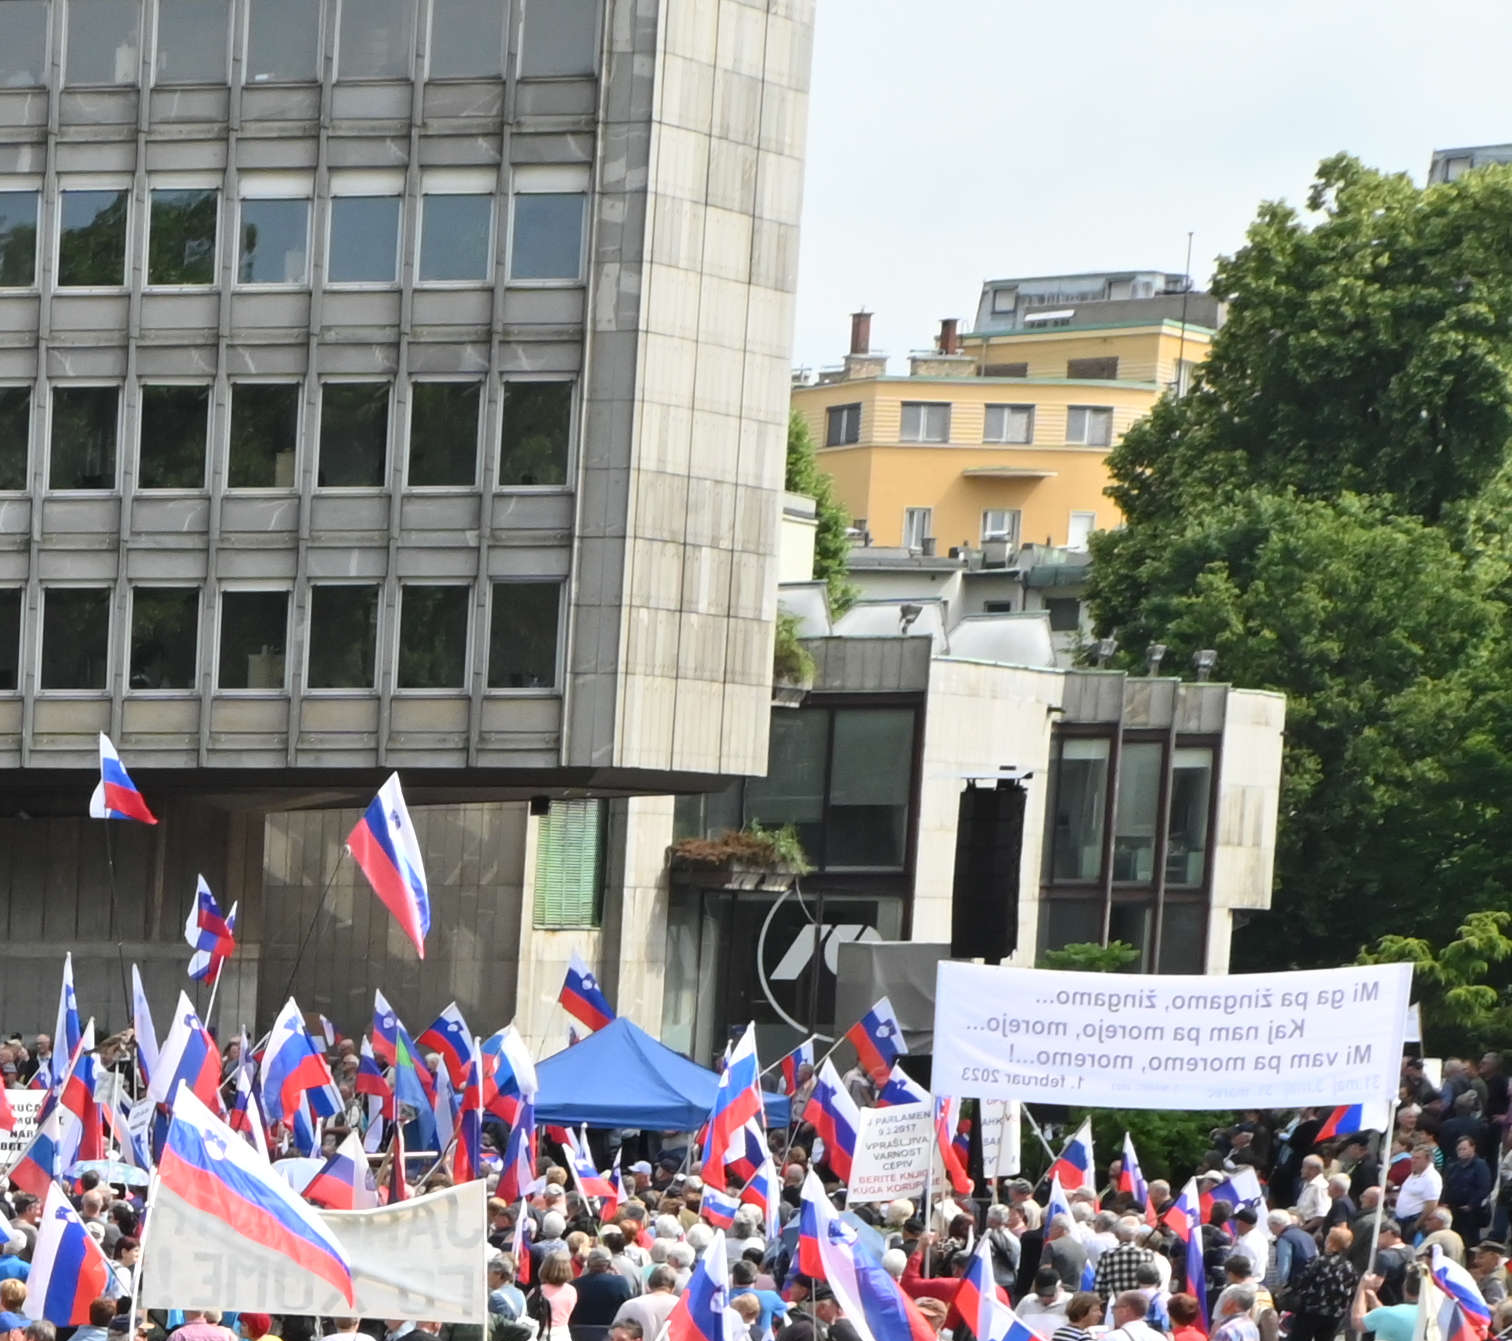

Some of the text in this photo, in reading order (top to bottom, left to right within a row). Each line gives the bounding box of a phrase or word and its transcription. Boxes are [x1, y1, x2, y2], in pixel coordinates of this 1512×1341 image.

[873, 1148, 921, 1160] VARNOST
[882, 1160, 913, 1170] CEPIV
[859, 1174, 896, 1184] BERITE
[853, 1186, 882, 1194] KUGA
